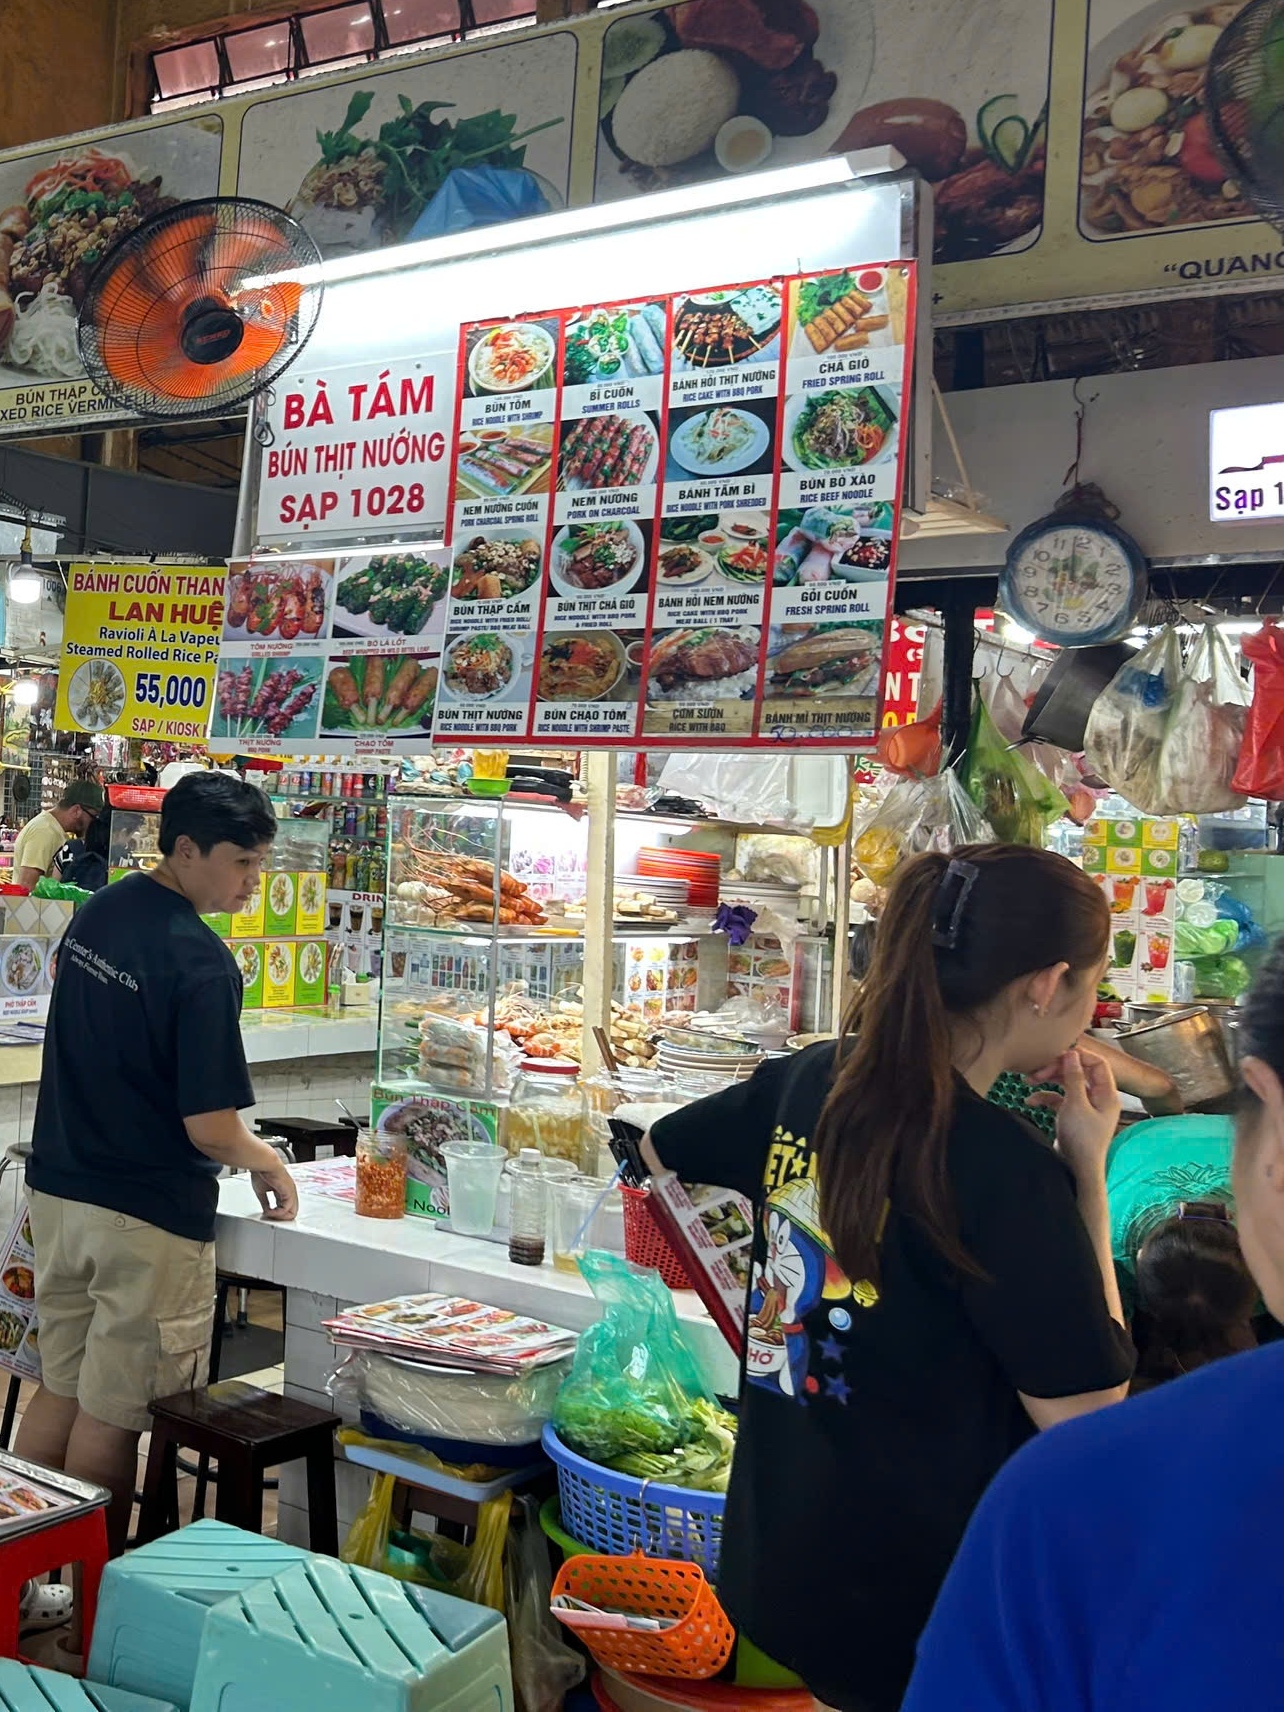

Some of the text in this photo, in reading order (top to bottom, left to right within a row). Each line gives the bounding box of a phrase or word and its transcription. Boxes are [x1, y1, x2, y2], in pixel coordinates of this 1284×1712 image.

[802, 371, 884, 388] FRIED SPRING ROLL
[16, 388, 45, 405] BÚN
[284, 369, 434, 430] BÀ TÁM
[31, 402, 64, 418] RICE
[582, 399, 640, 414] SUMMER ROLLS
[268, 427, 445, 480] BÚN THỊT NƯỚNG
[572, 494, 597, 507] NEM
[800, 489, 873, 503] RICE BEEF NOODLE
[1216, 486, 1264, 514] Sạp
[280, 483, 425, 530] SẠP 1028
[463, 505, 482, 516] NEM
[567, 506, 640, 520] PORK ON CHARCOAL
[74, 566, 166, 594] BÁNH CUỐN
[704, 595, 724, 606] NEM
[786, 602, 869, 616] FRESH SPRING ROLL
[109, 601, 223, 631] LAN HUỆ
[99, 626, 175, 644] Ravioli À La
[67, 642, 201, 663] Steamed Rolled Rice
[136, 673, 205, 708] 55,000
[132, 718, 154, 739] SẠP
[166, 721, 199, 738] KIOSK
[119, 971, 139, 991] Club
